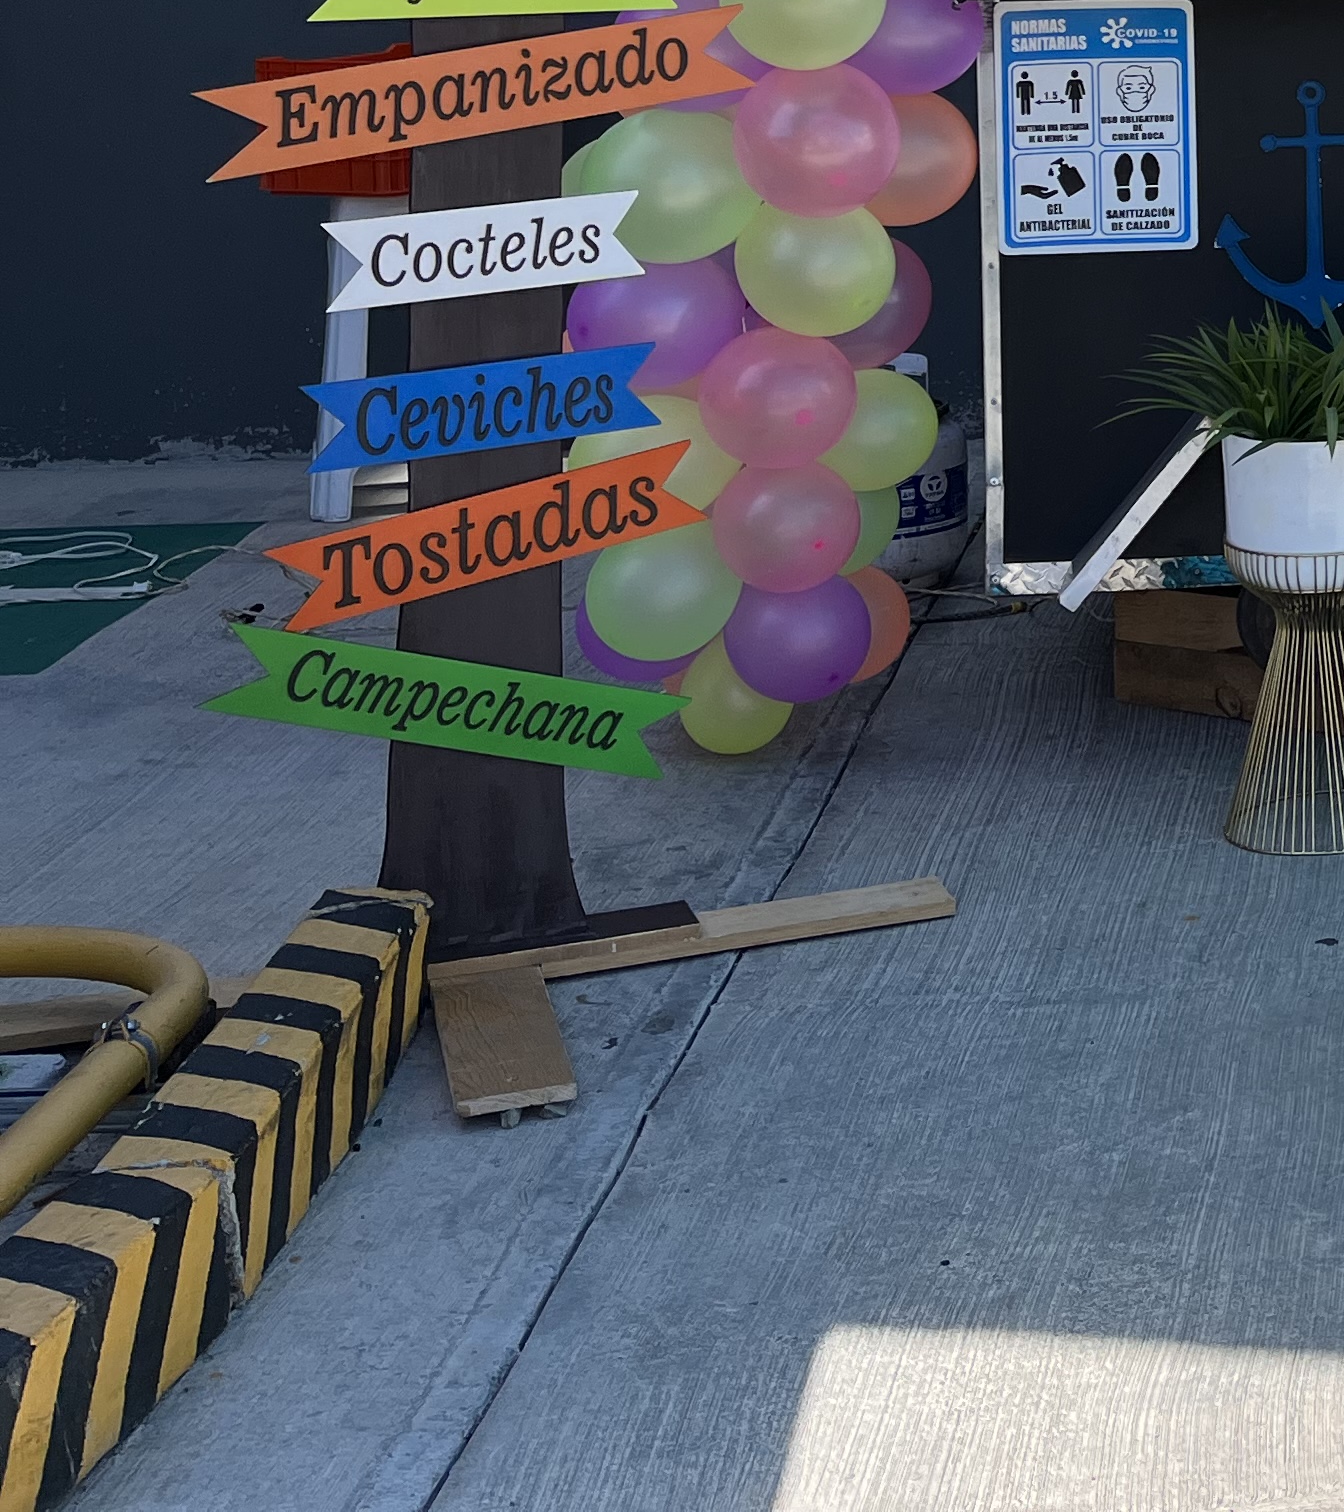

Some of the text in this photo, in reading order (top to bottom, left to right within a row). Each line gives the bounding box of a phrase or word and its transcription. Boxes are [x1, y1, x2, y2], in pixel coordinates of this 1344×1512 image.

[1011, 18, 1067, 35] NORMAS
[1117, 28, 1178, 38] COVID-19
[1011, 35, 1088, 53] SANITARIAS
[276, 28, 689, 148] Empanizado
[1047, 203, 1063, 215] GEL
[1106, 206, 1175, 219] SANITIZACIÓN
[1019, 219, 1092, 232] ANTIBACTERIAL
[1111, 220, 1170, 231] DE CALZADO
[371, 218, 601, 287] Cocteles
[356, 366, 614, 456] Ceviches
[323, 476, 658, 609] Tostadas
[286, 650, 624, 752] Campechana
